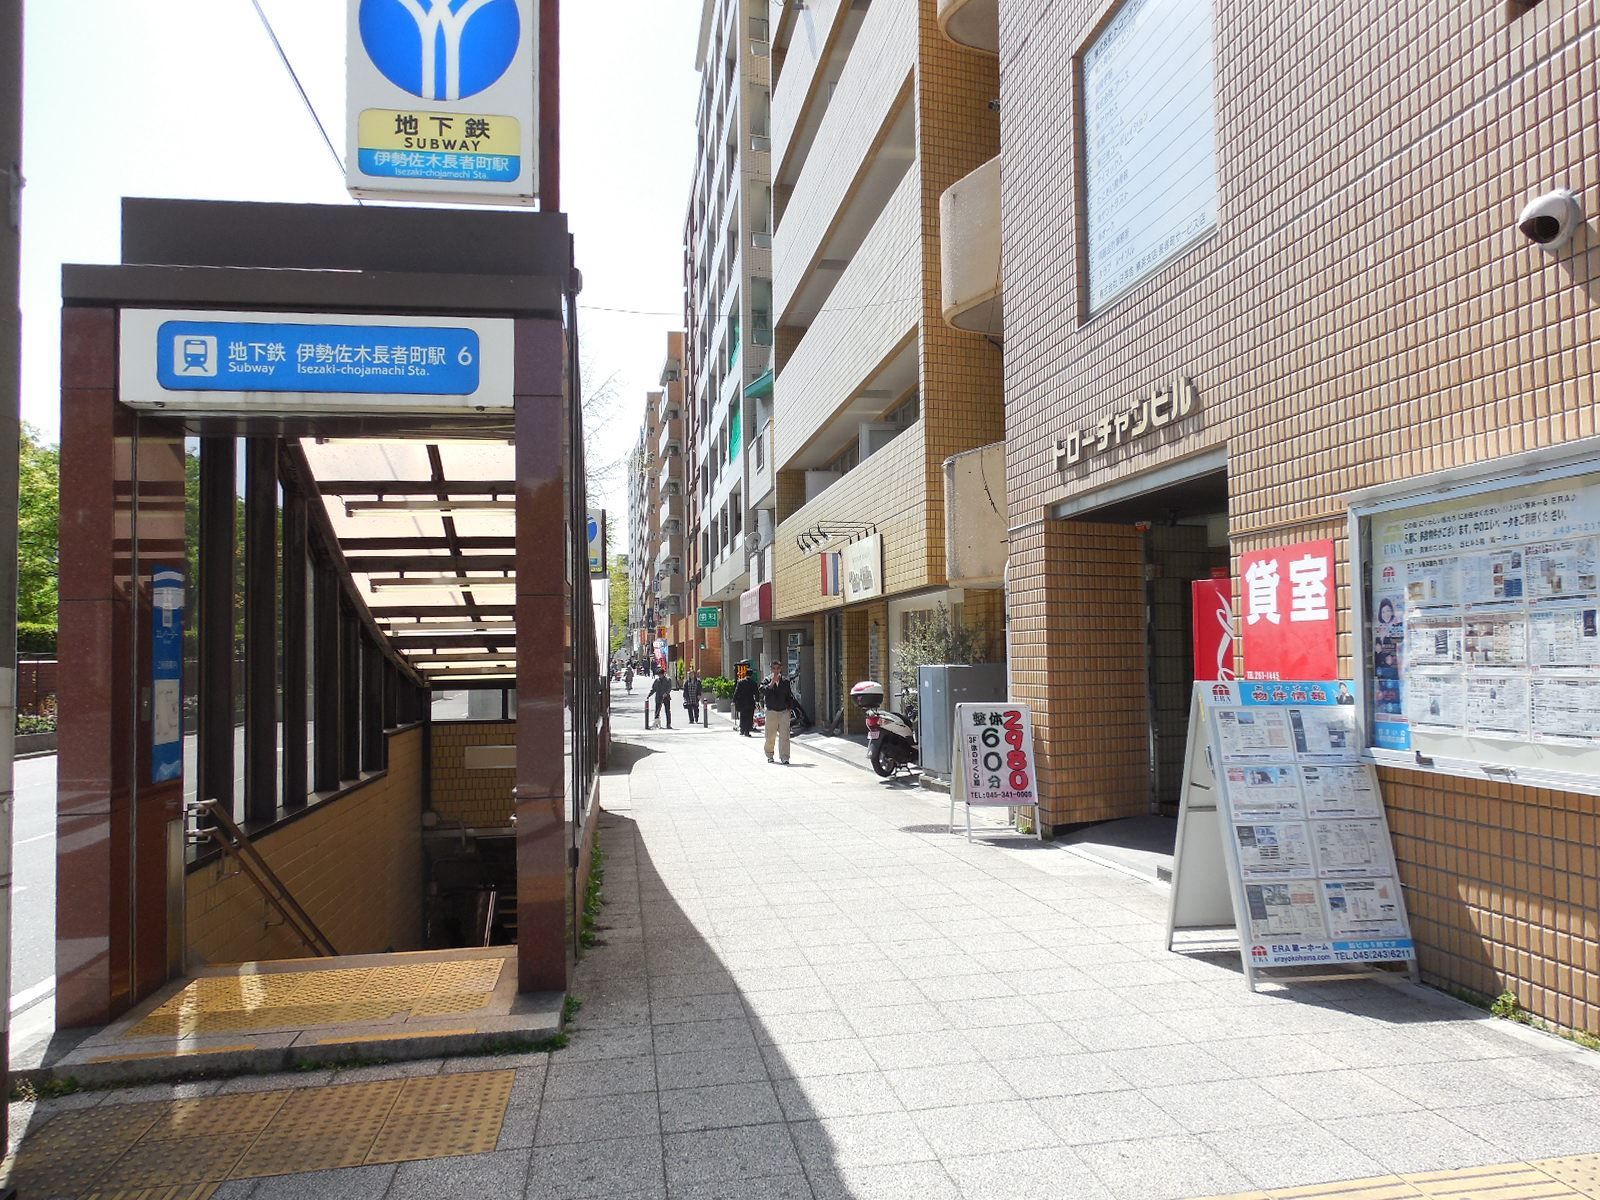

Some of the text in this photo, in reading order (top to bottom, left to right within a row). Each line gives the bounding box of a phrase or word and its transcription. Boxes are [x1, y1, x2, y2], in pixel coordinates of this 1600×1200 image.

[394, 114, 490, 139] 地下鉄
[404, 137, 481, 151] SUBWAY
[374, 151, 510, 172] 伊勢佐木長者町駅
[395, 169, 489, 180] Isezaki-chojamachi Sta.
[227, 342, 473, 366] 地下鉄 伊勢佐木長者町駅 6
[228, 361, 430, 377] Subway Isezaki-chojamachi Sta.
[1052, 376, 1193, 471] トローチャンビル
[1245, 554, 1329, 625] 貸室
[1252, 691, 1327, 702] 物件情報
[1003, 710, 1029, 790] 2980
[1272, 945, 1290, 953] ERA
